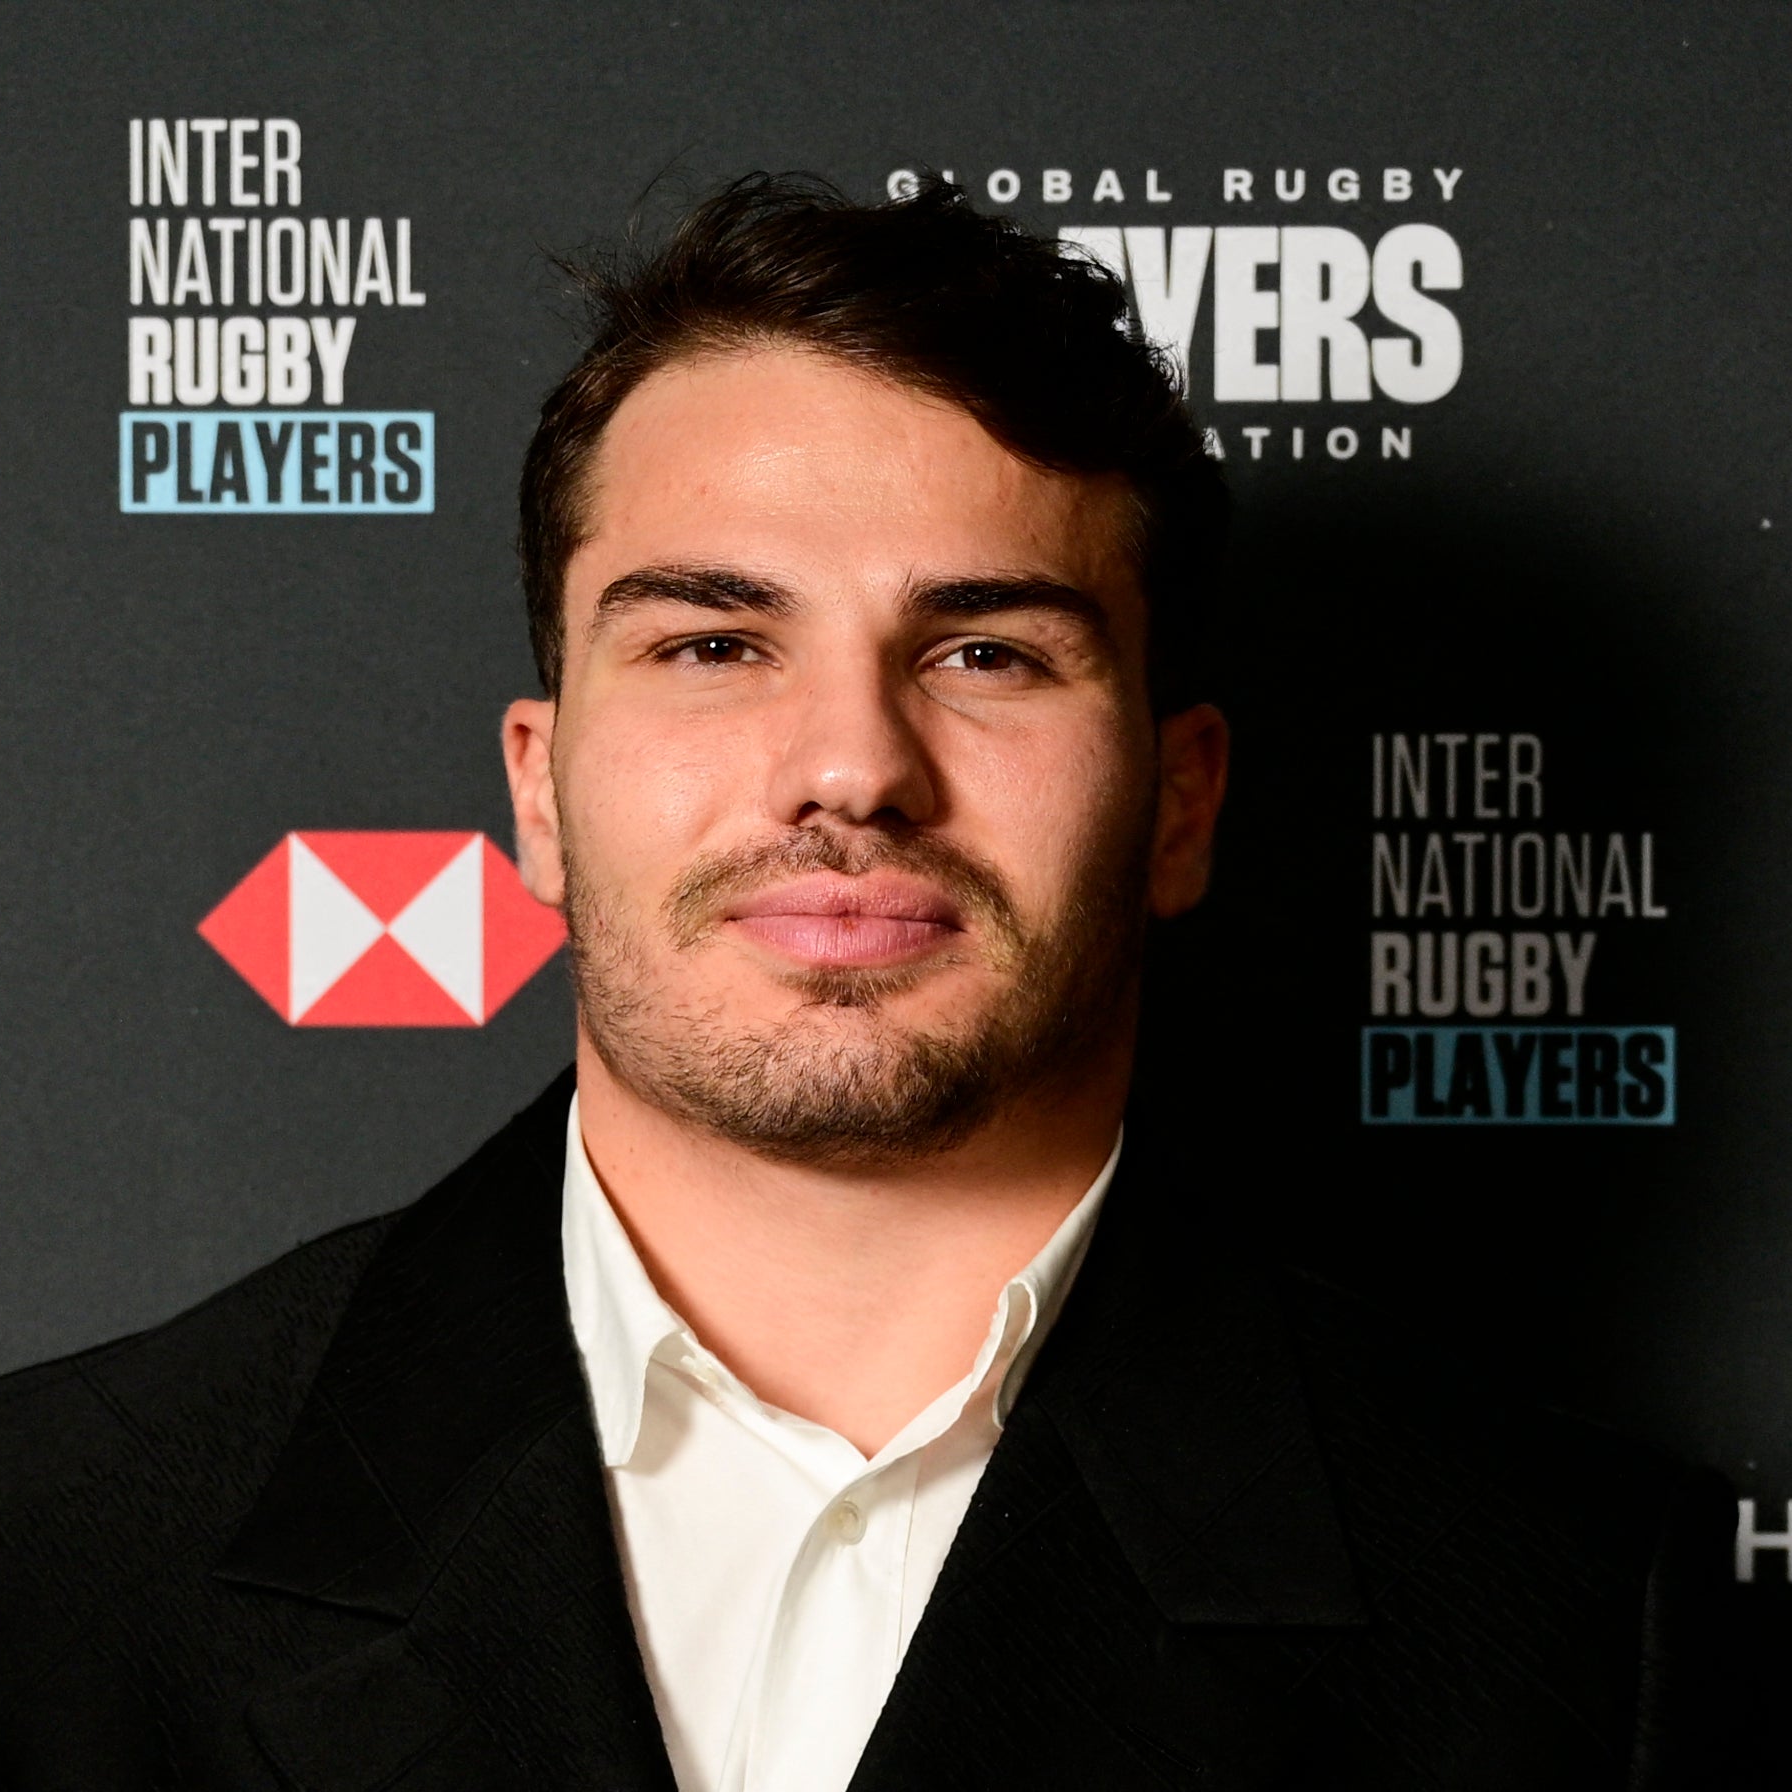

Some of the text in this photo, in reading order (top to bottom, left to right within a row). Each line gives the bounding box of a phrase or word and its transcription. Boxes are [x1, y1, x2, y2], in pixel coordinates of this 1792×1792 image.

[130, 119, 301, 206] INTER
[1224, 168, 1462, 201] RUGBY
[130, 218, 425, 306] NATIONAL
[129, 317, 355, 405] RUGBY
[133, 425, 422, 503] PLAYERS
[1374, 734, 1541, 818] INTER
[1373, 833, 1668, 918] NATIONAL
[1372, 932, 1595, 1016] RUGBY
[1373, 1036, 1665, 1117] PLAYERS
